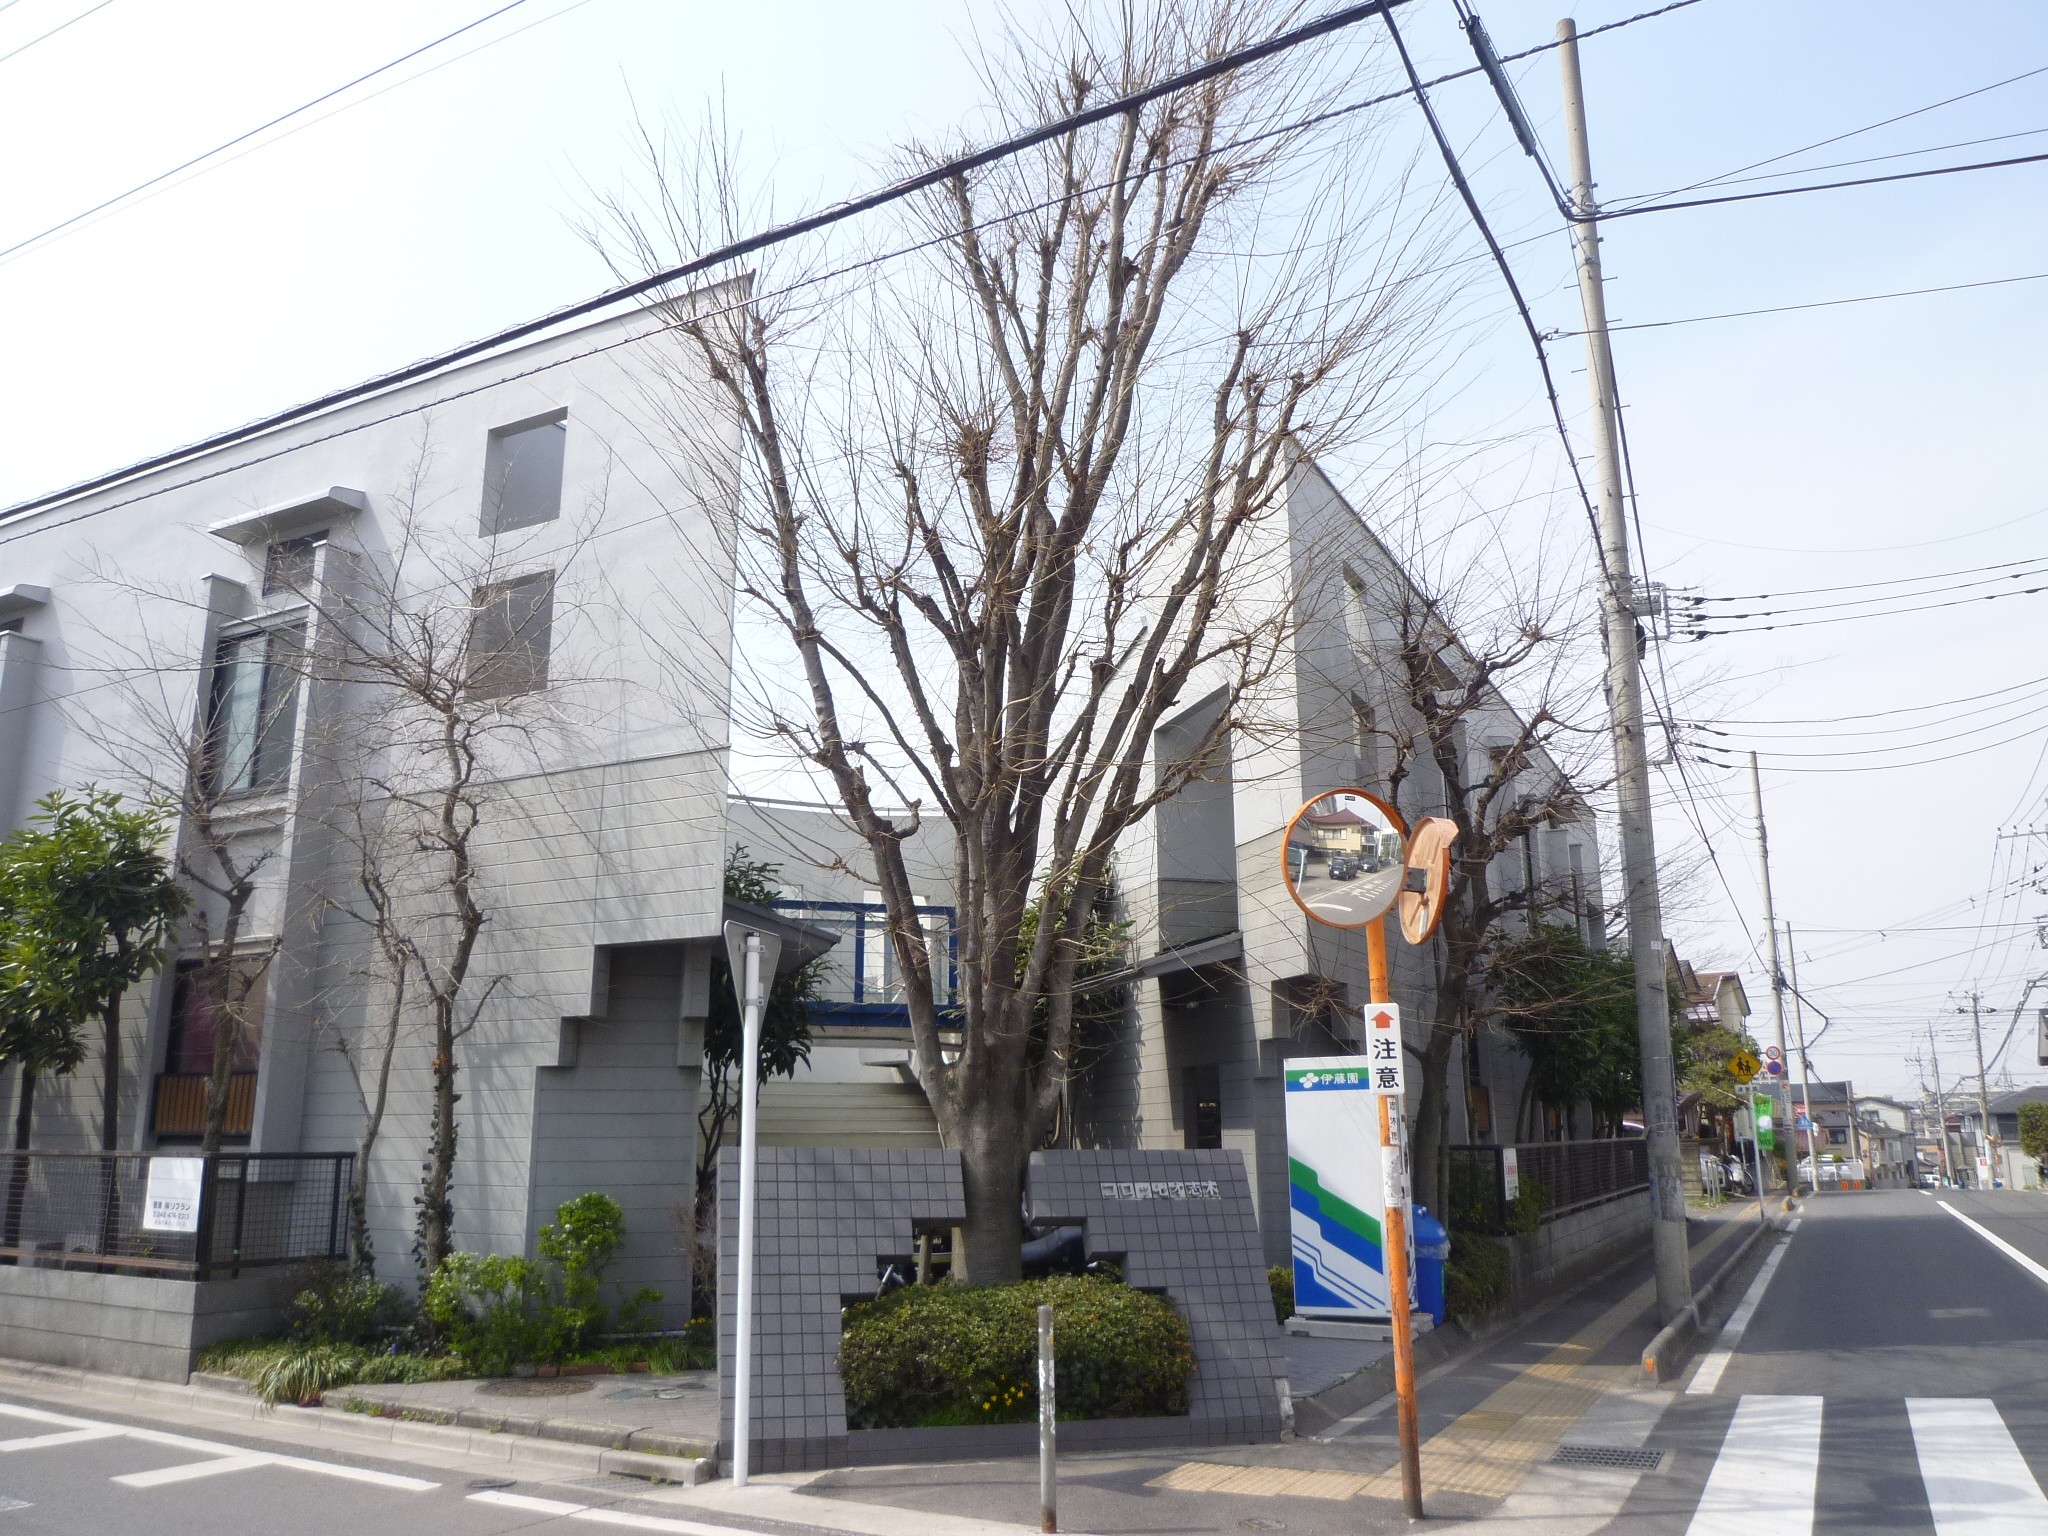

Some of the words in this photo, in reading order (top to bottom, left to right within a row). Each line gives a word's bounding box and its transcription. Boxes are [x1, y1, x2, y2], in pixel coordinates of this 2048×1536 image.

[1320, 1072, 1359, 1085] 伊藤園
[1373, 1038, 1399, 1089] 注意
